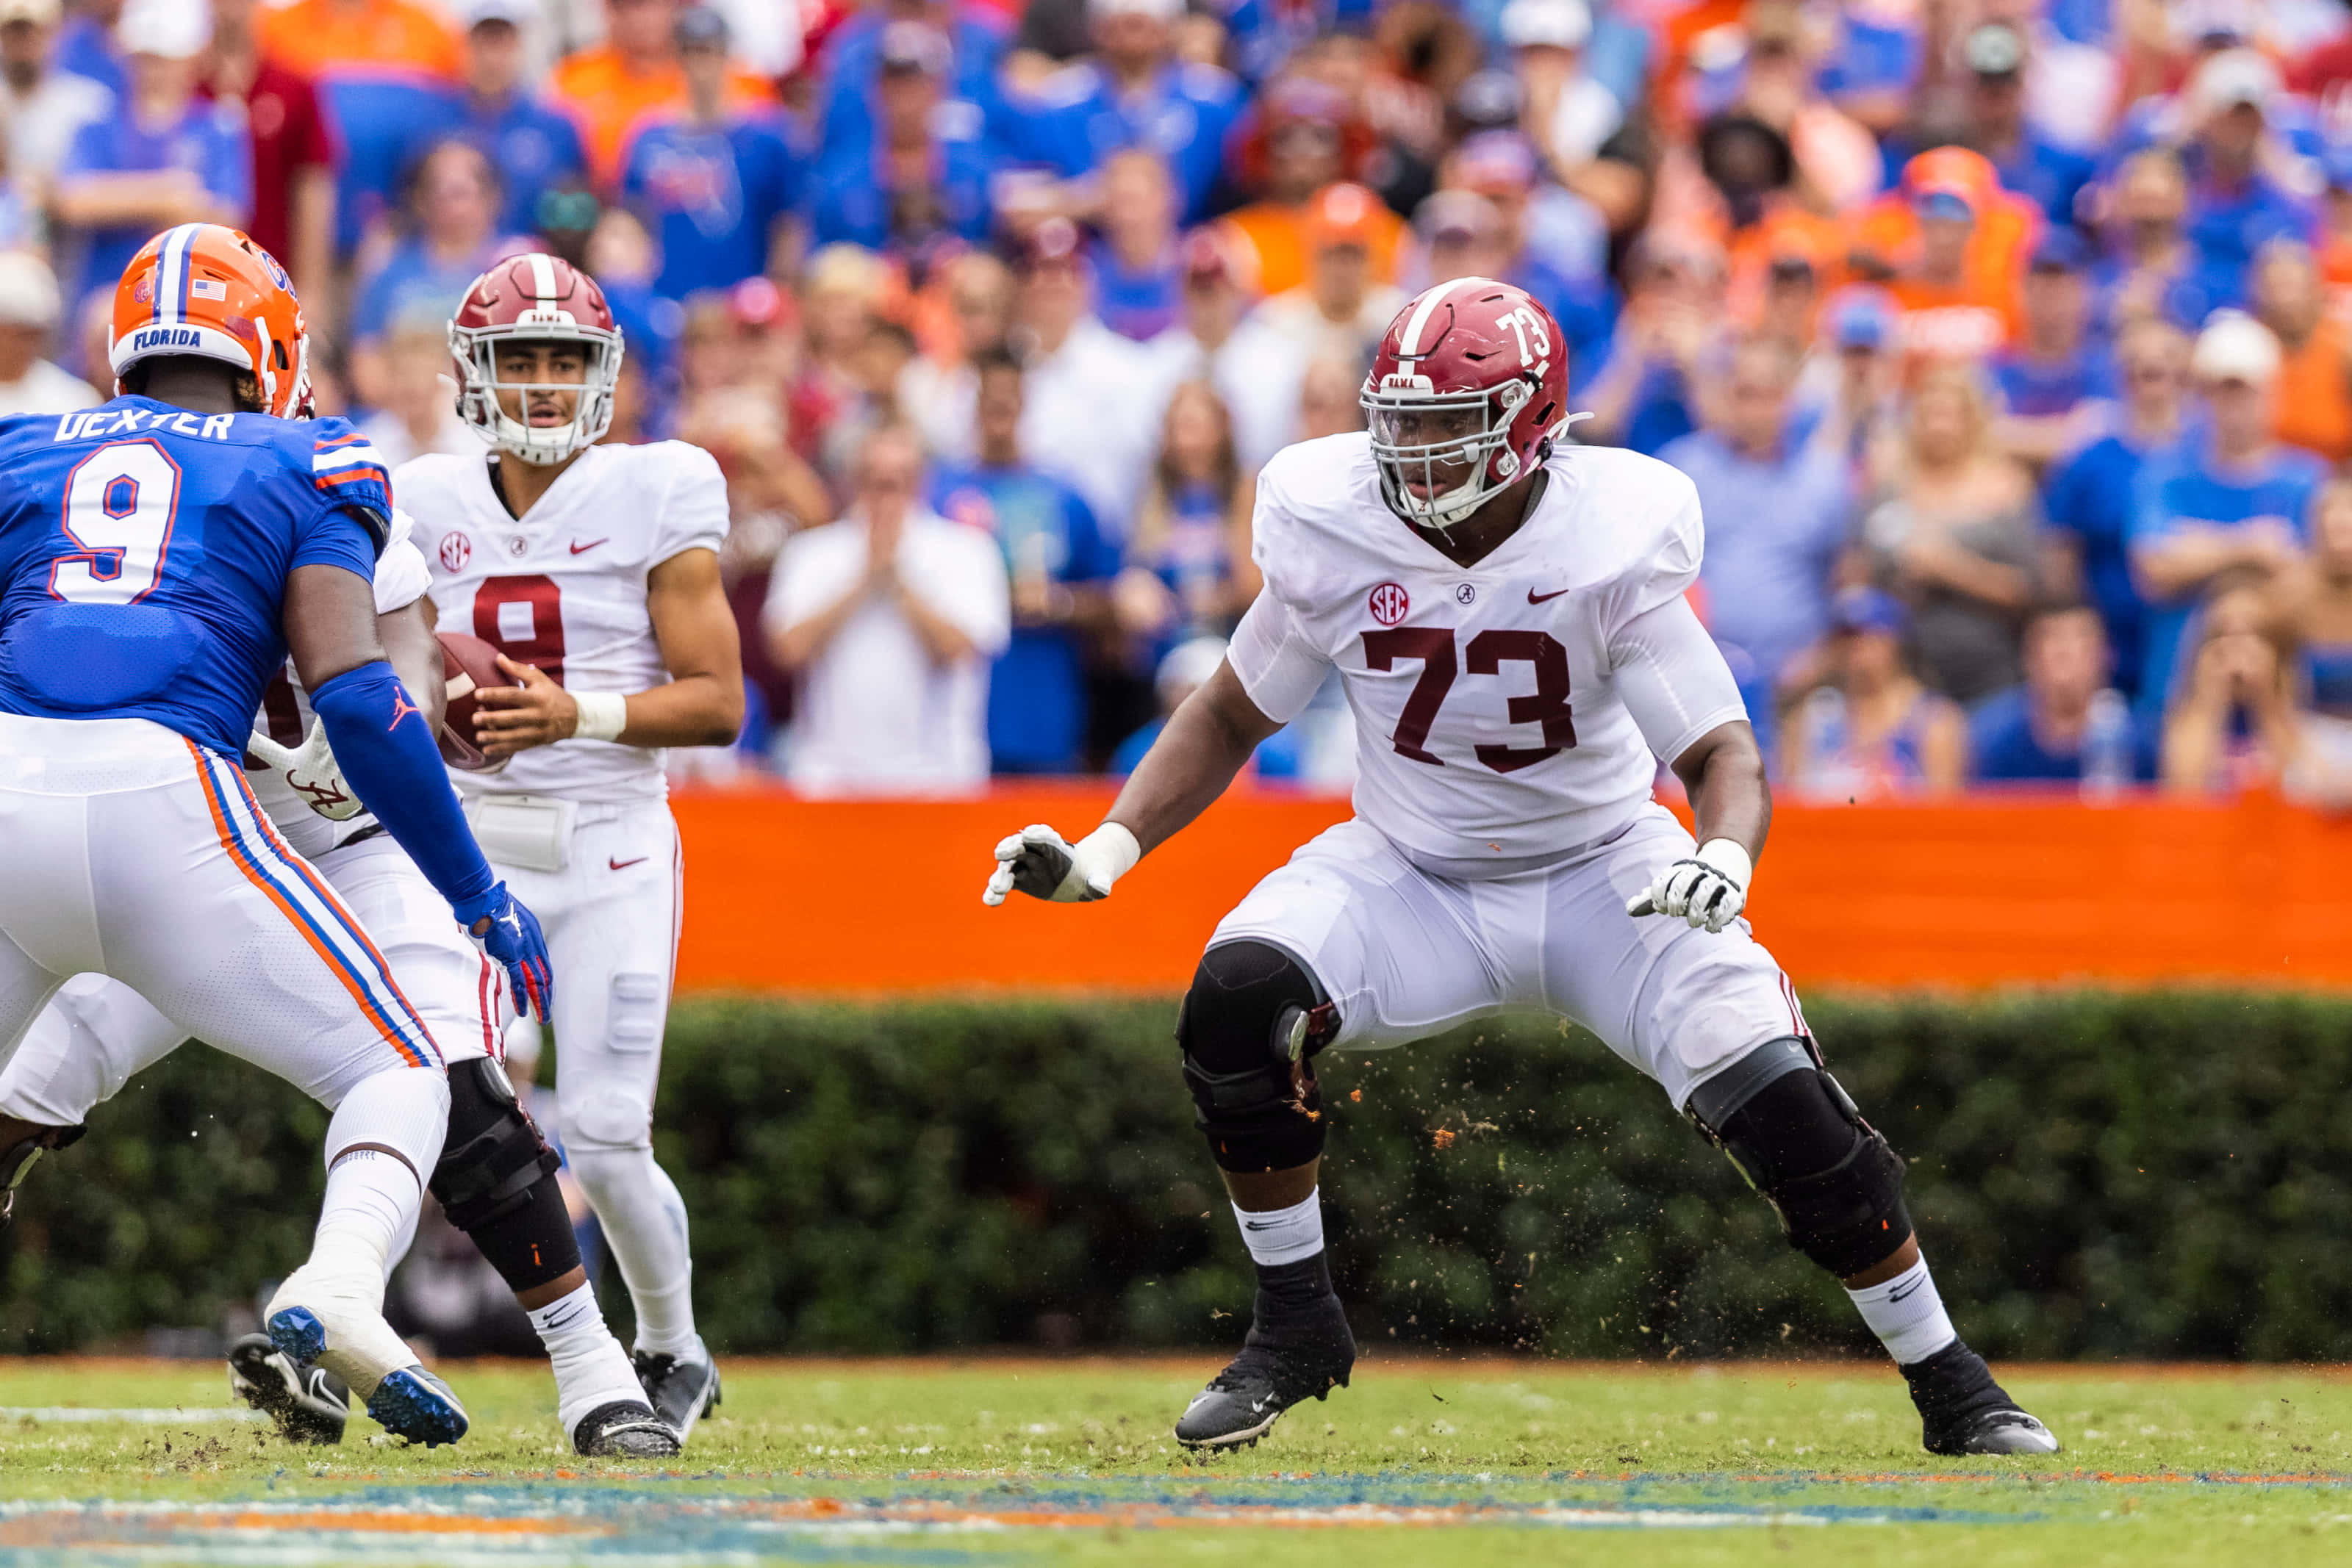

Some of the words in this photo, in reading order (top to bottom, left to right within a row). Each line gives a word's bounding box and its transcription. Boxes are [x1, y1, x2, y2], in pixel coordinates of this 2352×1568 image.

[134, 329, 201, 350] FLORIDA
[1495, 307, 1550, 367] 73
[1388, 377, 1415, 389] BAMA
[54, 409, 235, 442] DEXTER
[48, 438, 182, 605] 9
[440, 533, 470, 572] SEC
[1370, 584, 1408, 624] SEC
[1360, 627, 1577, 774] 73
